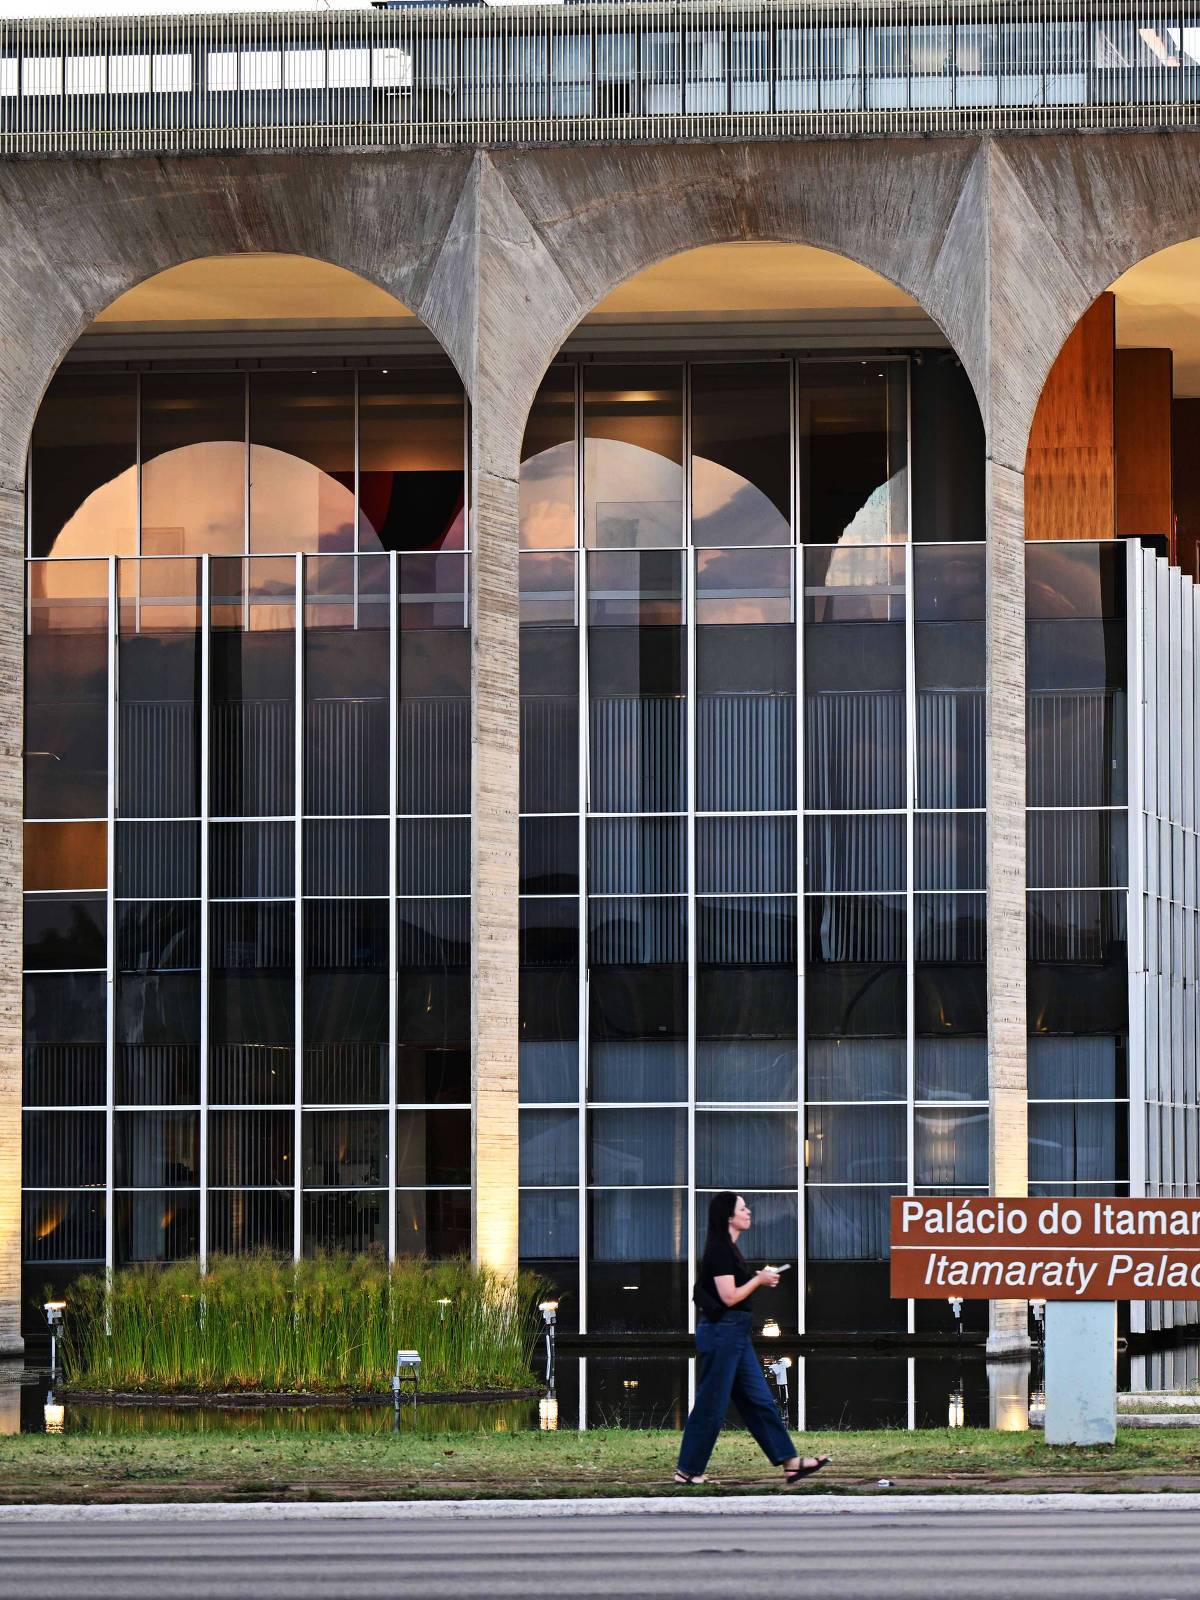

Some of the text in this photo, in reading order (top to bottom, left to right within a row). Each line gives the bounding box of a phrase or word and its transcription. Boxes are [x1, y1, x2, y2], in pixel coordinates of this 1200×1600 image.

[902, 1200, 1028, 1235] Palácio
[1038, 1202, 1082, 1235] do
[924, 1253, 1098, 1295] Itamaraty
